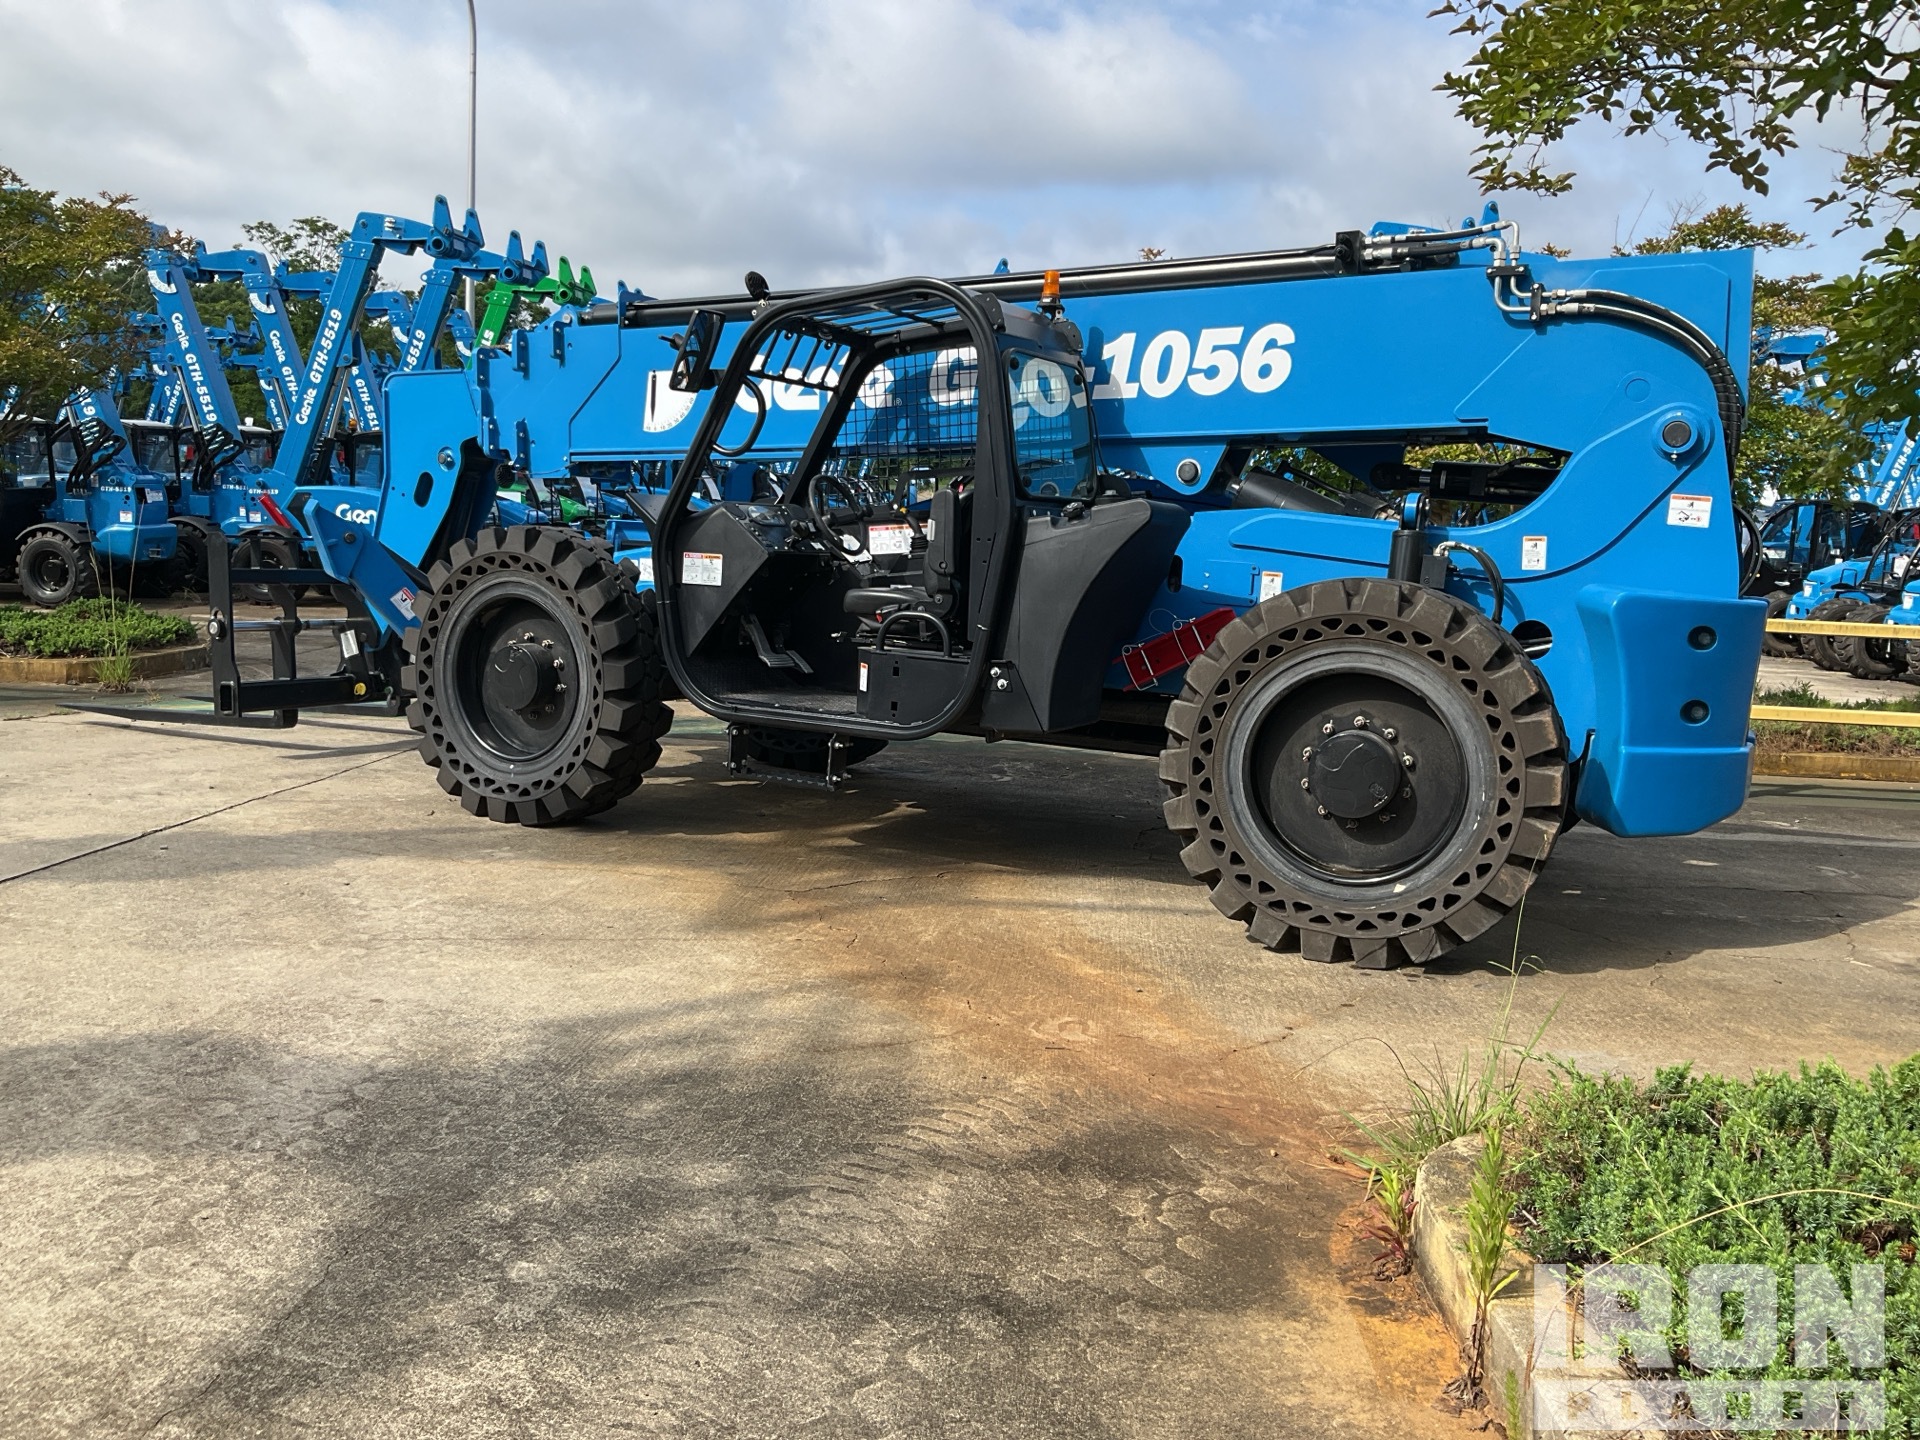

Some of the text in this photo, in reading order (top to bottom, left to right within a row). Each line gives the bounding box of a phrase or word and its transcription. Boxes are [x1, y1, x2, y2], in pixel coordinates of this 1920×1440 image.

[171, 312, 217, 423] Genie GTH-5519
[269, 330, 286, 364] Genie
[295, 309, 342, 425] Genie GTH-5519
[735, 350, 894, 413] Gene
